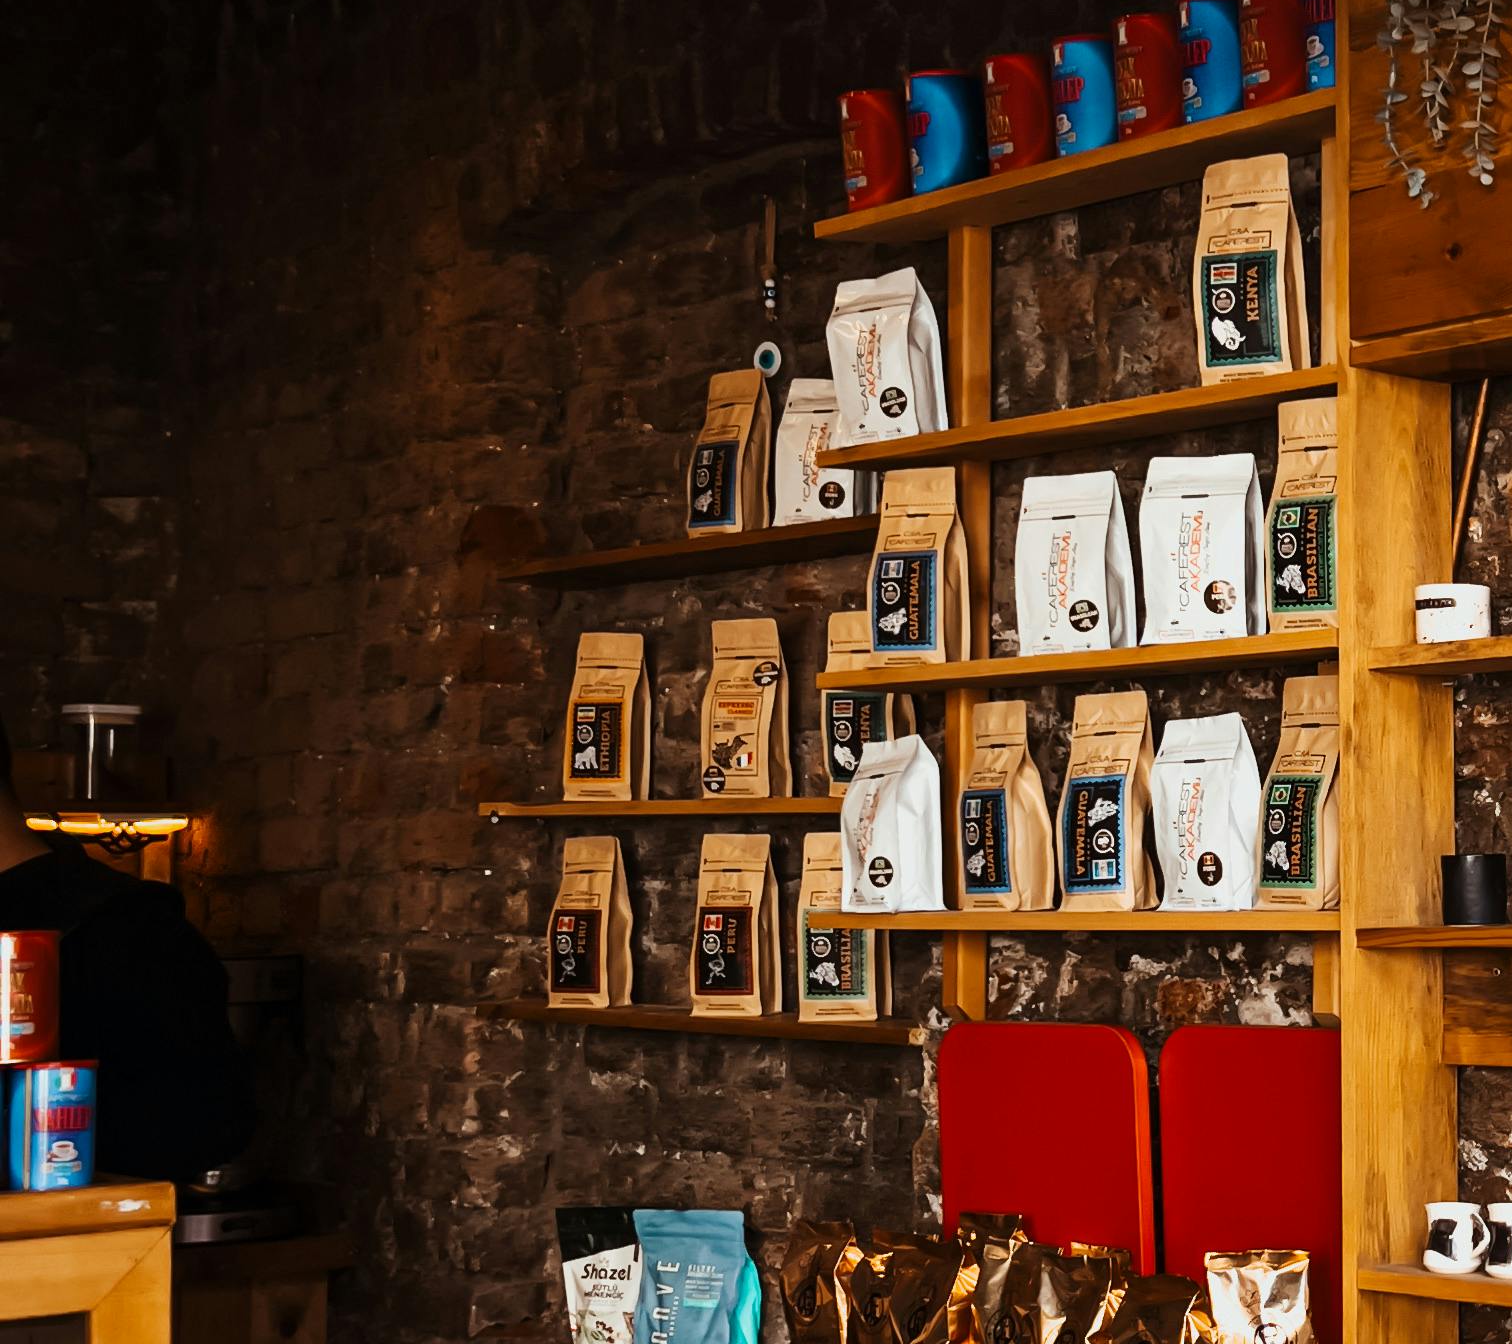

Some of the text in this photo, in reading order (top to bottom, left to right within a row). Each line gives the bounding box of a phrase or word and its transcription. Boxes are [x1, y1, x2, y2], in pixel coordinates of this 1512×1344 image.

[1246, 265, 1260, 323] KENYA
[1305, 507, 1320, 599] BRASILIAN
[908, 560, 921, 641] GUATEMALA
[600, 710, 611, 772] ETHIOPIA
[860, 704, 872, 747] ENYA
[985, 800, 997, 882] GUATEMALA
[1075, 790, 1089, 876] GUATEMALA
[1290, 786, 1307, 876] BRASILIAN
[576, 919, 587, 955] PERU
[726, 917, 738, 955] PERU
[840, 927, 852, 992] BRASILIA
[580, 1263, 632, 1281] Shazel
